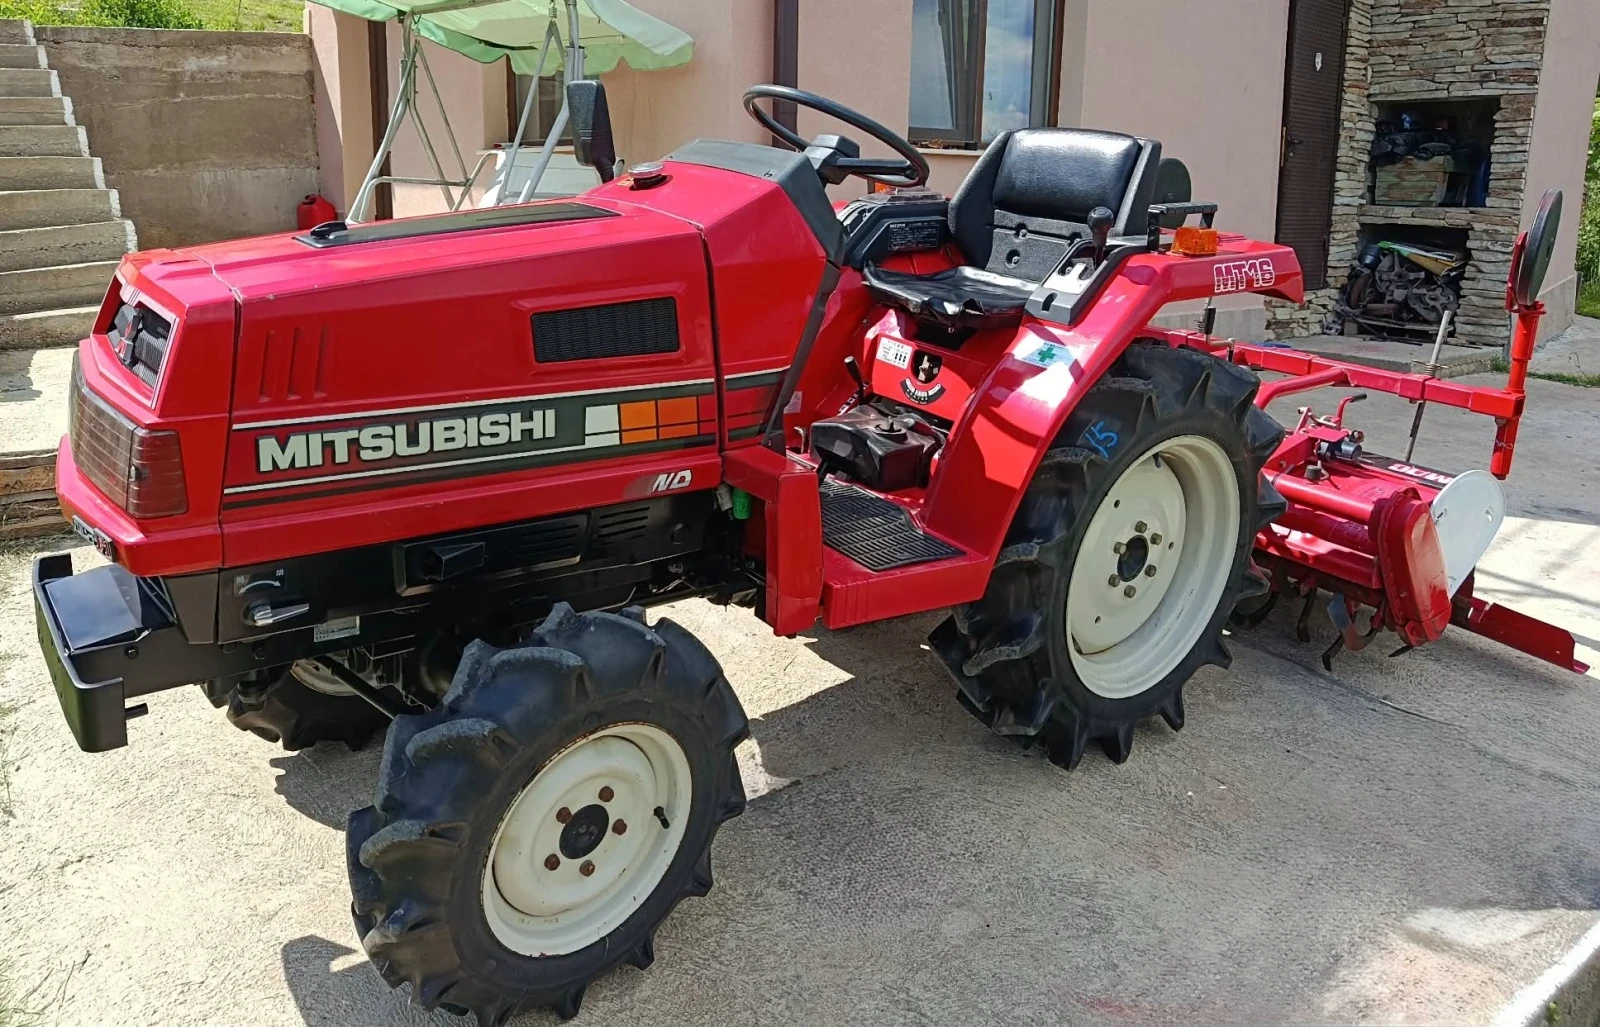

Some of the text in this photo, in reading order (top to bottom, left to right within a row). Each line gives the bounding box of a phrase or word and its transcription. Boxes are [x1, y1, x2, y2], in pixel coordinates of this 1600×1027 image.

[1213, 258, 1275, 293] MT16
[257, 408, 556, 472] MITSUBISHI
[1085, 421, 1118, 458] 15
